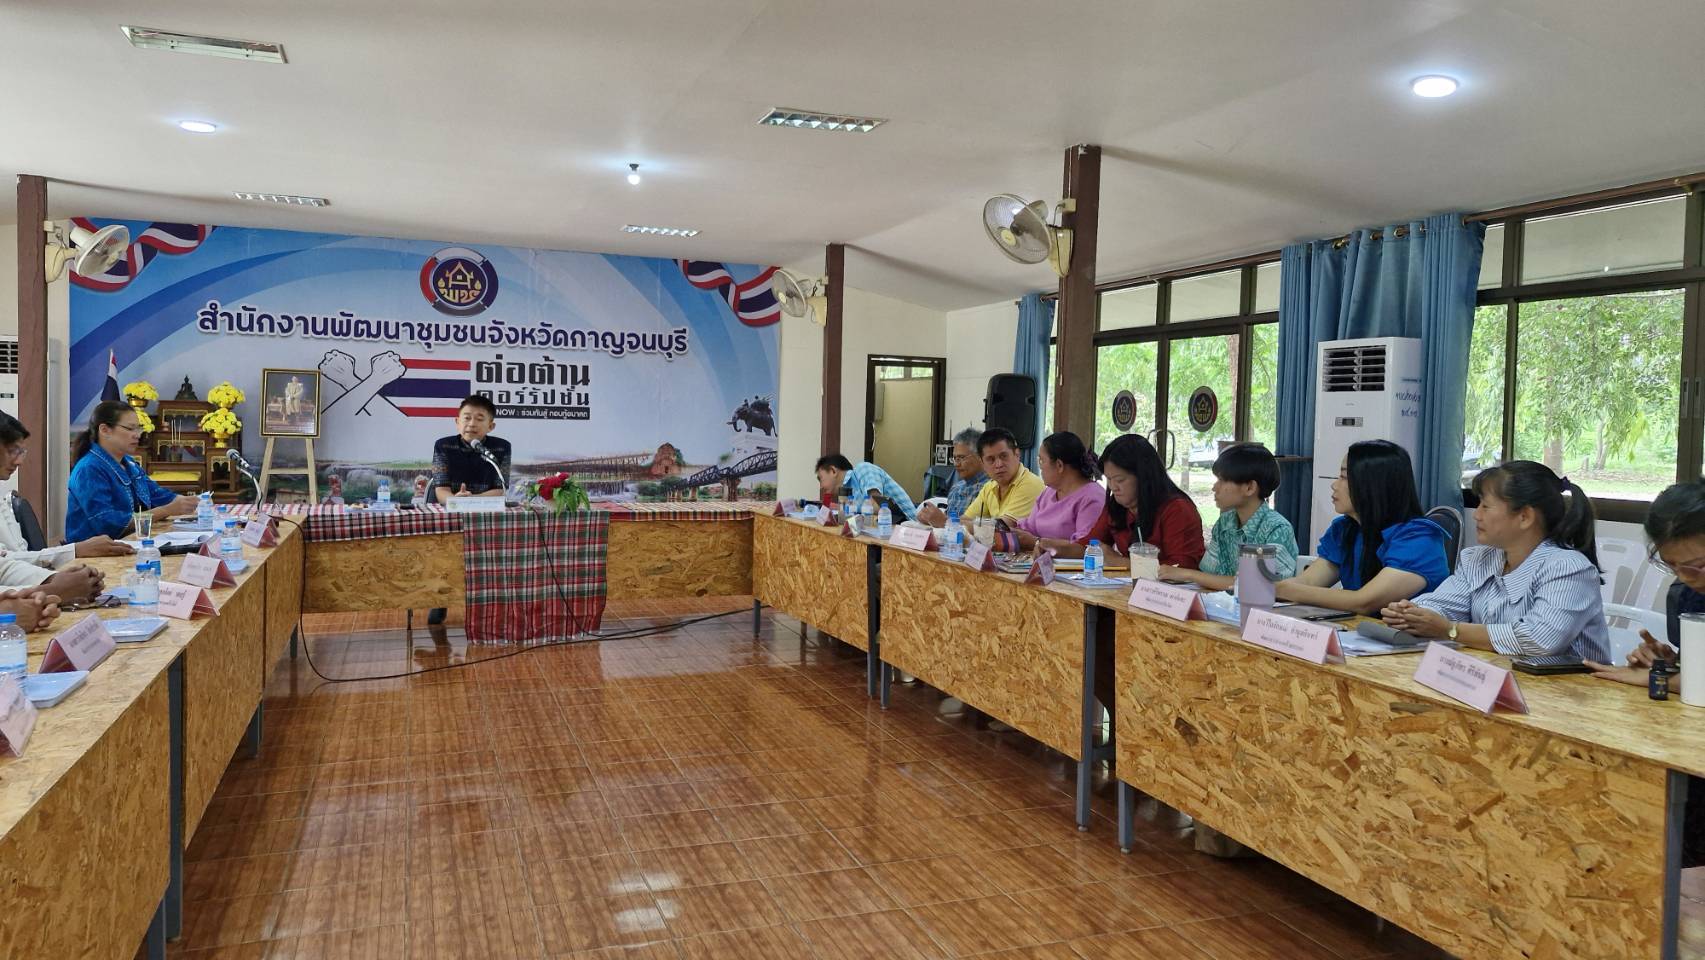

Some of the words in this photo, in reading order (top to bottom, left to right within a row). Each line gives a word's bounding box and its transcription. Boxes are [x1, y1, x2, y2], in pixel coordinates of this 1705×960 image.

[199, 302, 688, 359] สำนักงานพัฒนาชุมชนจังหวัดกาญจนบุรี
[476, 353, 590, 386] ต่อต้าน
[496, 408, 516, 416] NOW
